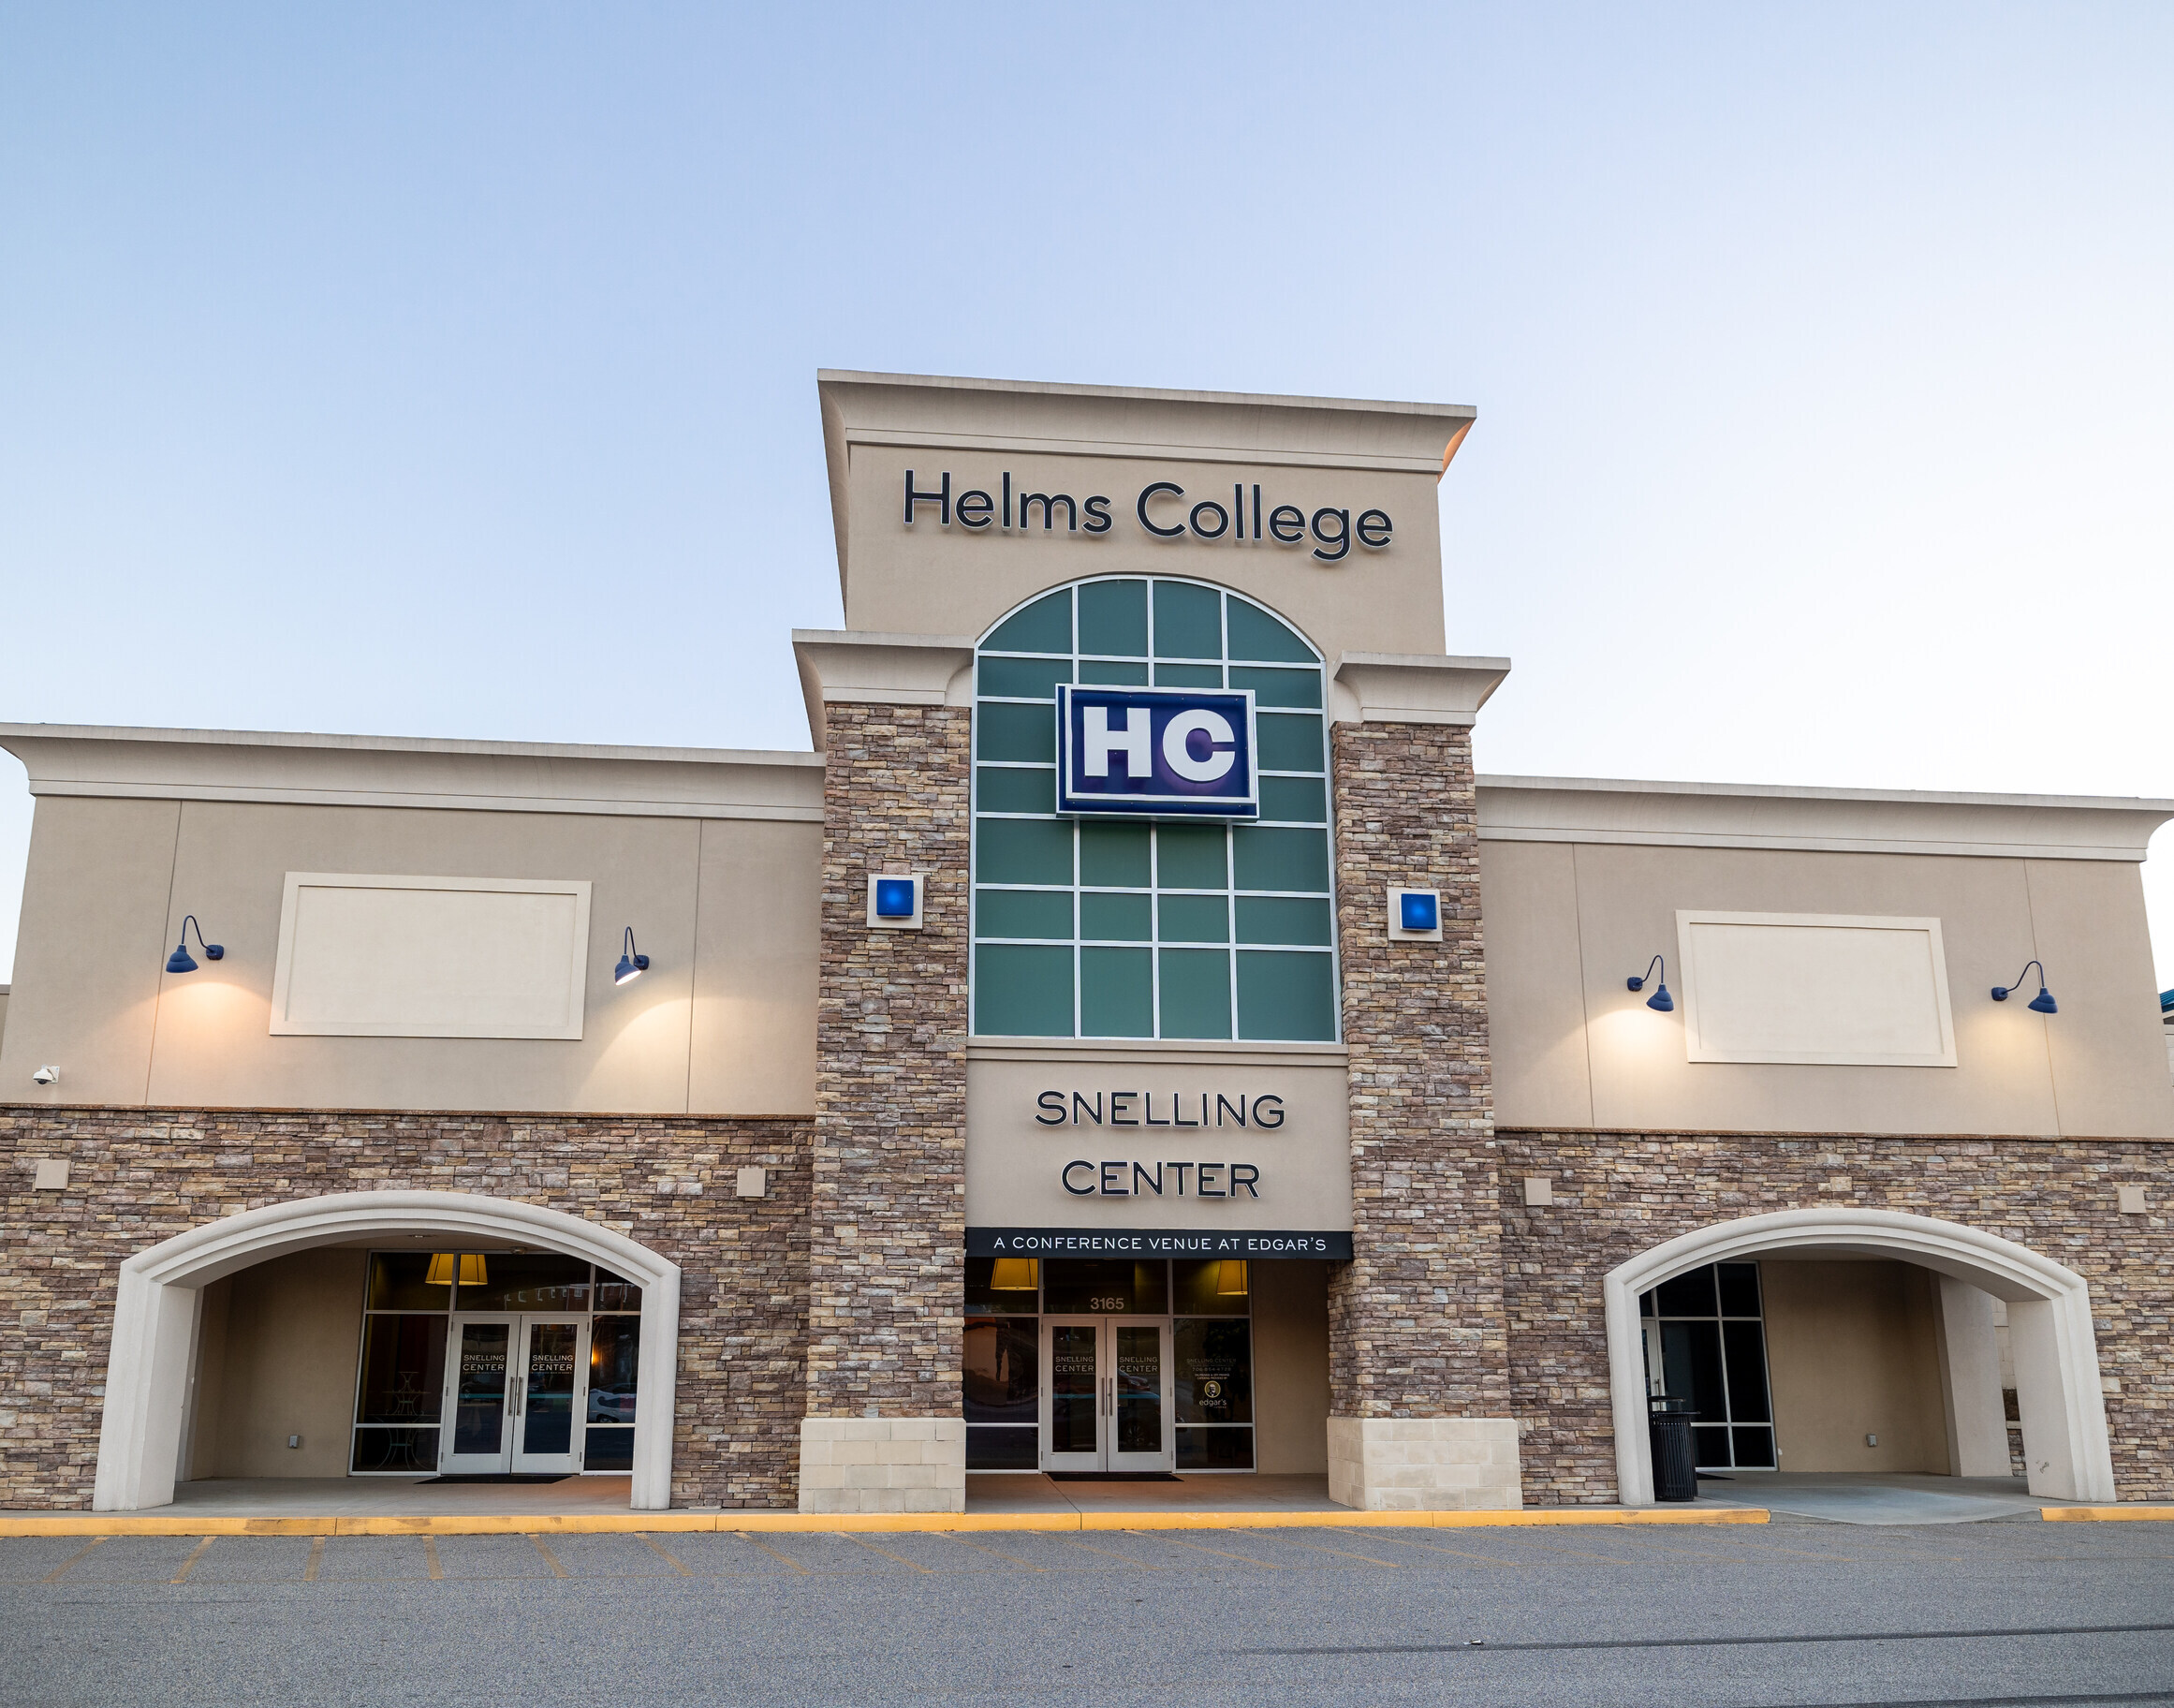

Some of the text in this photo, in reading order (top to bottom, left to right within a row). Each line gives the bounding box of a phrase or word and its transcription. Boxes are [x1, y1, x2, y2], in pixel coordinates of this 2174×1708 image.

[903, 469, 1394, 562] Helms College
[1083, 705, 1236, 782] HC
[1035, 1090, 1285, 1130] SNELLING
[1060, 1159, 1261, 1199] CENTER
[993, 1236, 1327, 1251] A CONFERENCE VENUE AT EDGAR'S
[1090, 1297, 1124, 1310] 3165
[1198, 1398, 1227, 1407] edgar's
